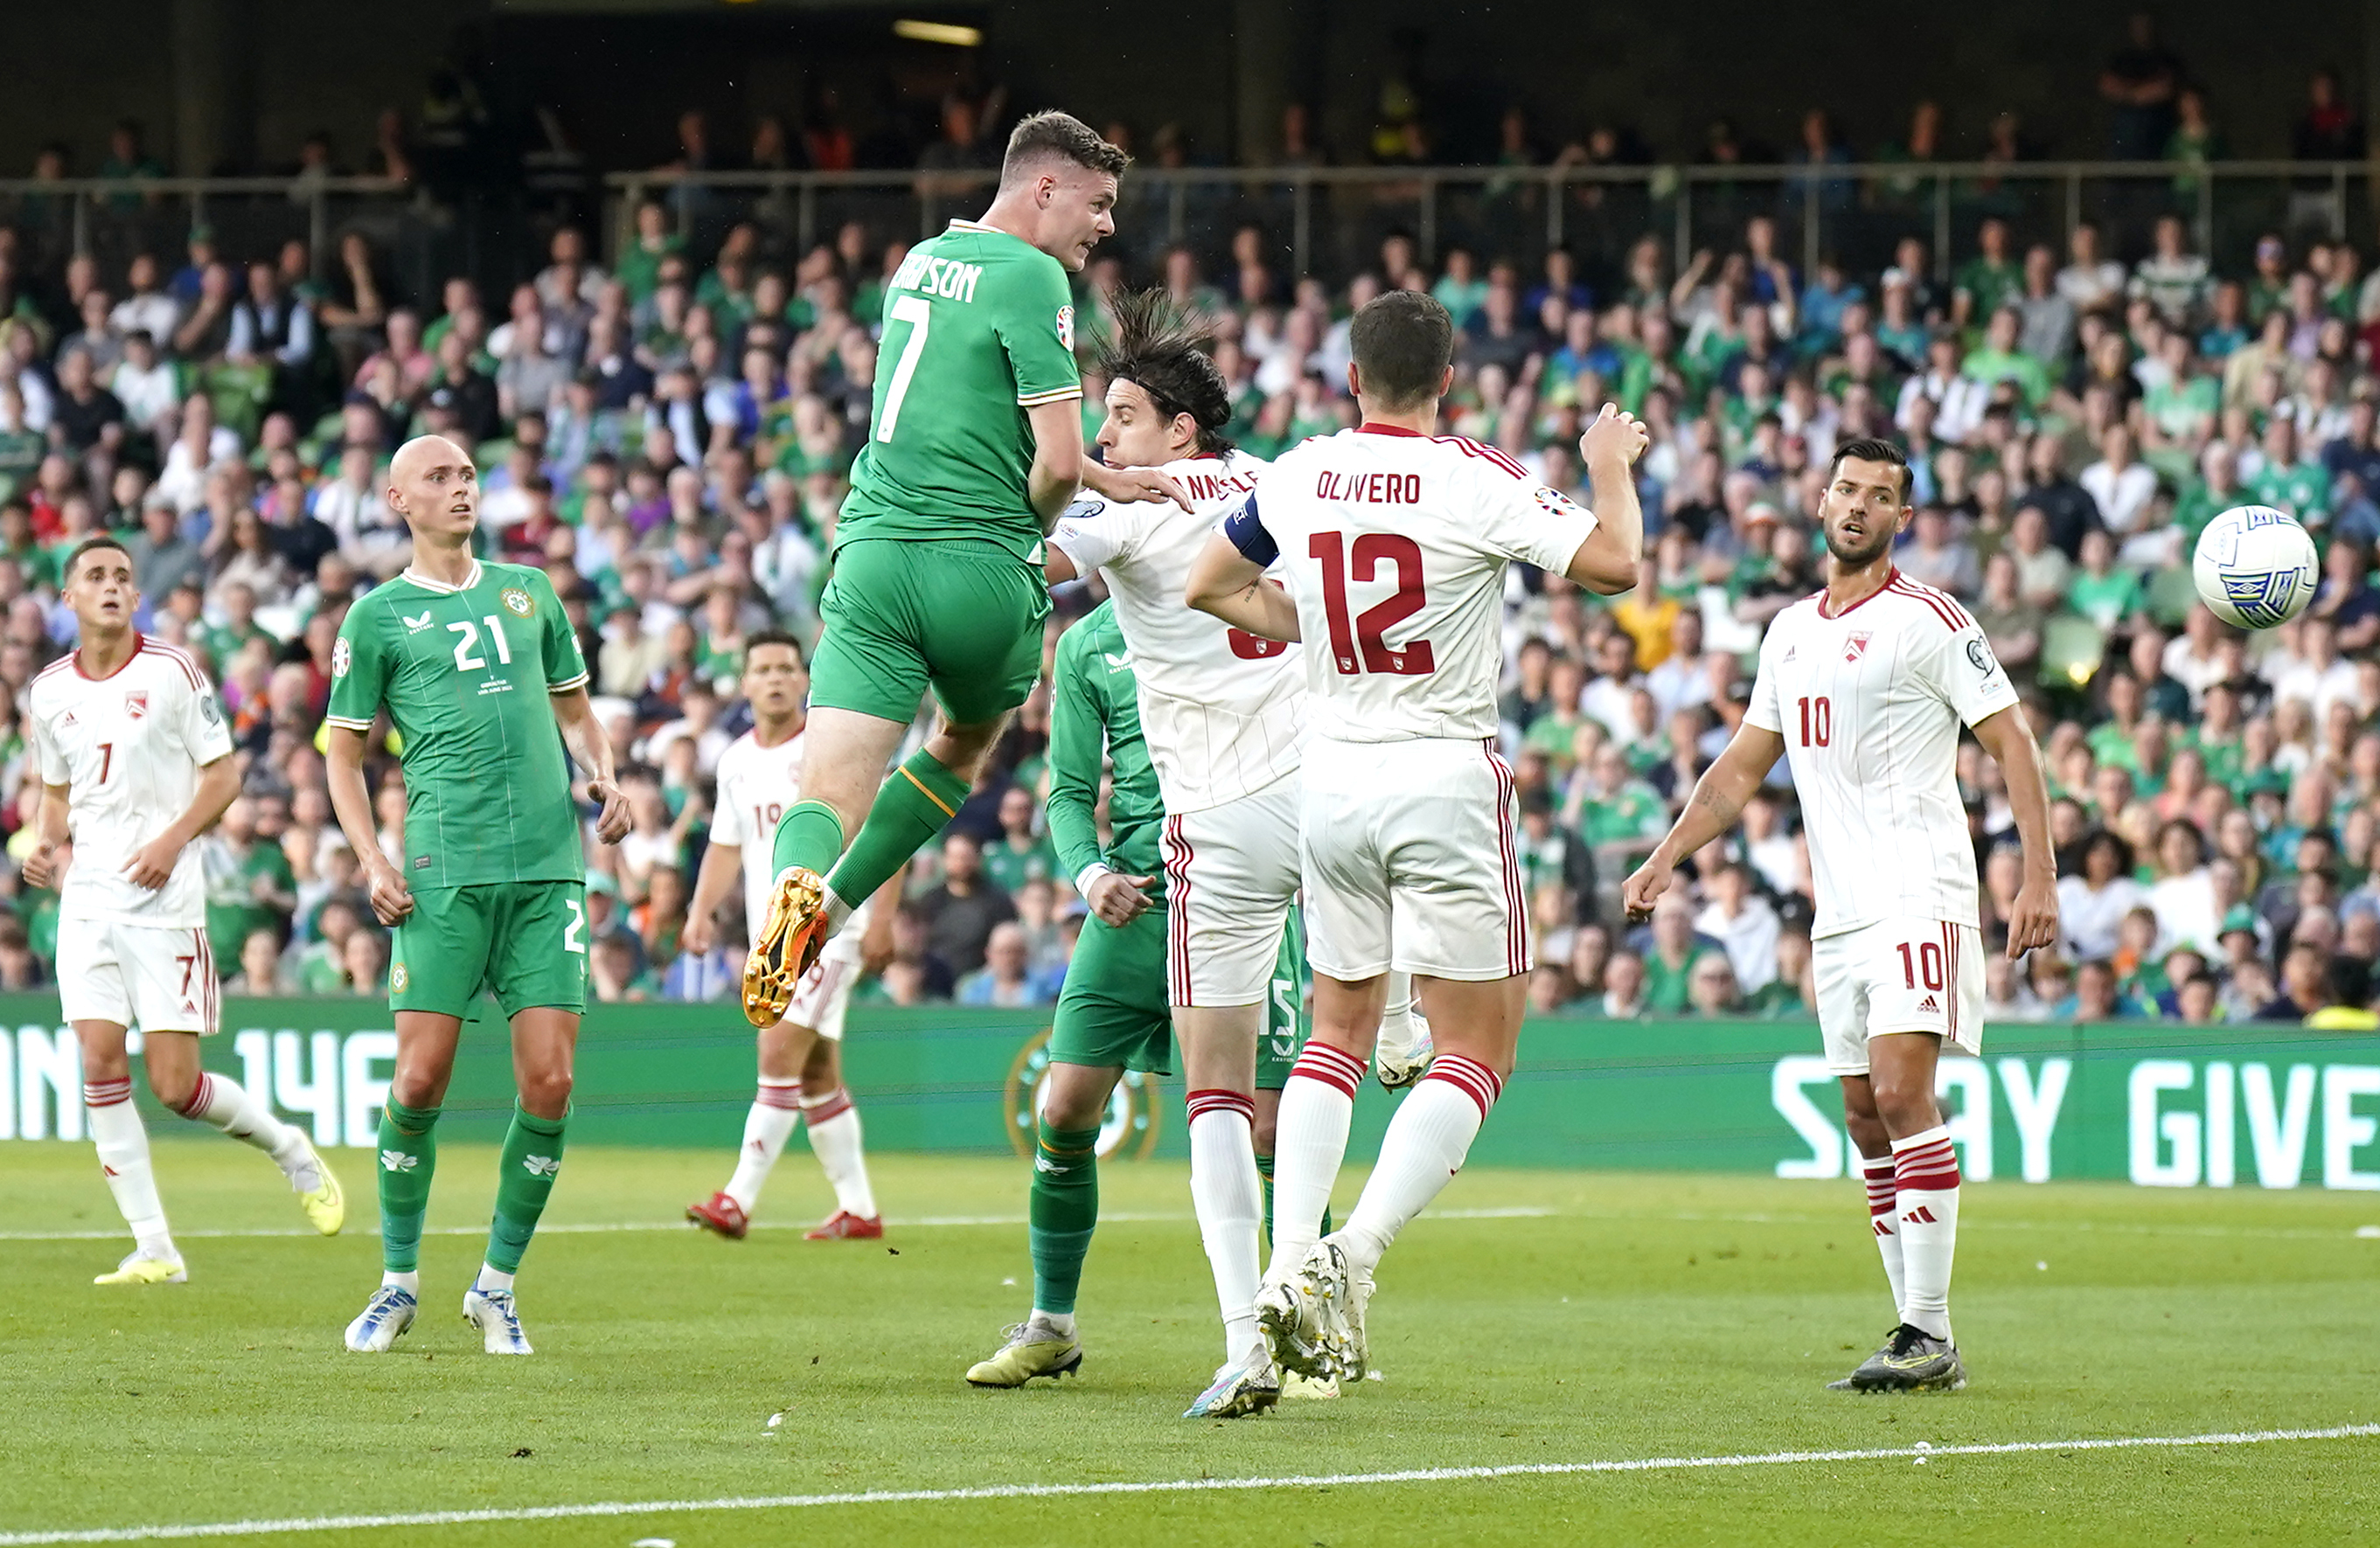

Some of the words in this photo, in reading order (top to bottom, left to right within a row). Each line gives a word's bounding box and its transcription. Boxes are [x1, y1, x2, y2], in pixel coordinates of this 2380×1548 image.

[876, 295, 930, 444] 7
[1317, 470, 1421, 504] OLIVERO
[1309, 531, 1436, 675] 12
[446, 614, 511, 671] 21
[1798, 696, 1830, 747] 10
[96, 742, 113, 785] 7
[176, 954, 195, 996] 7
[1896, 941, 1944, 992] 10
[1771, 1055, 2074, 1184] SAY
